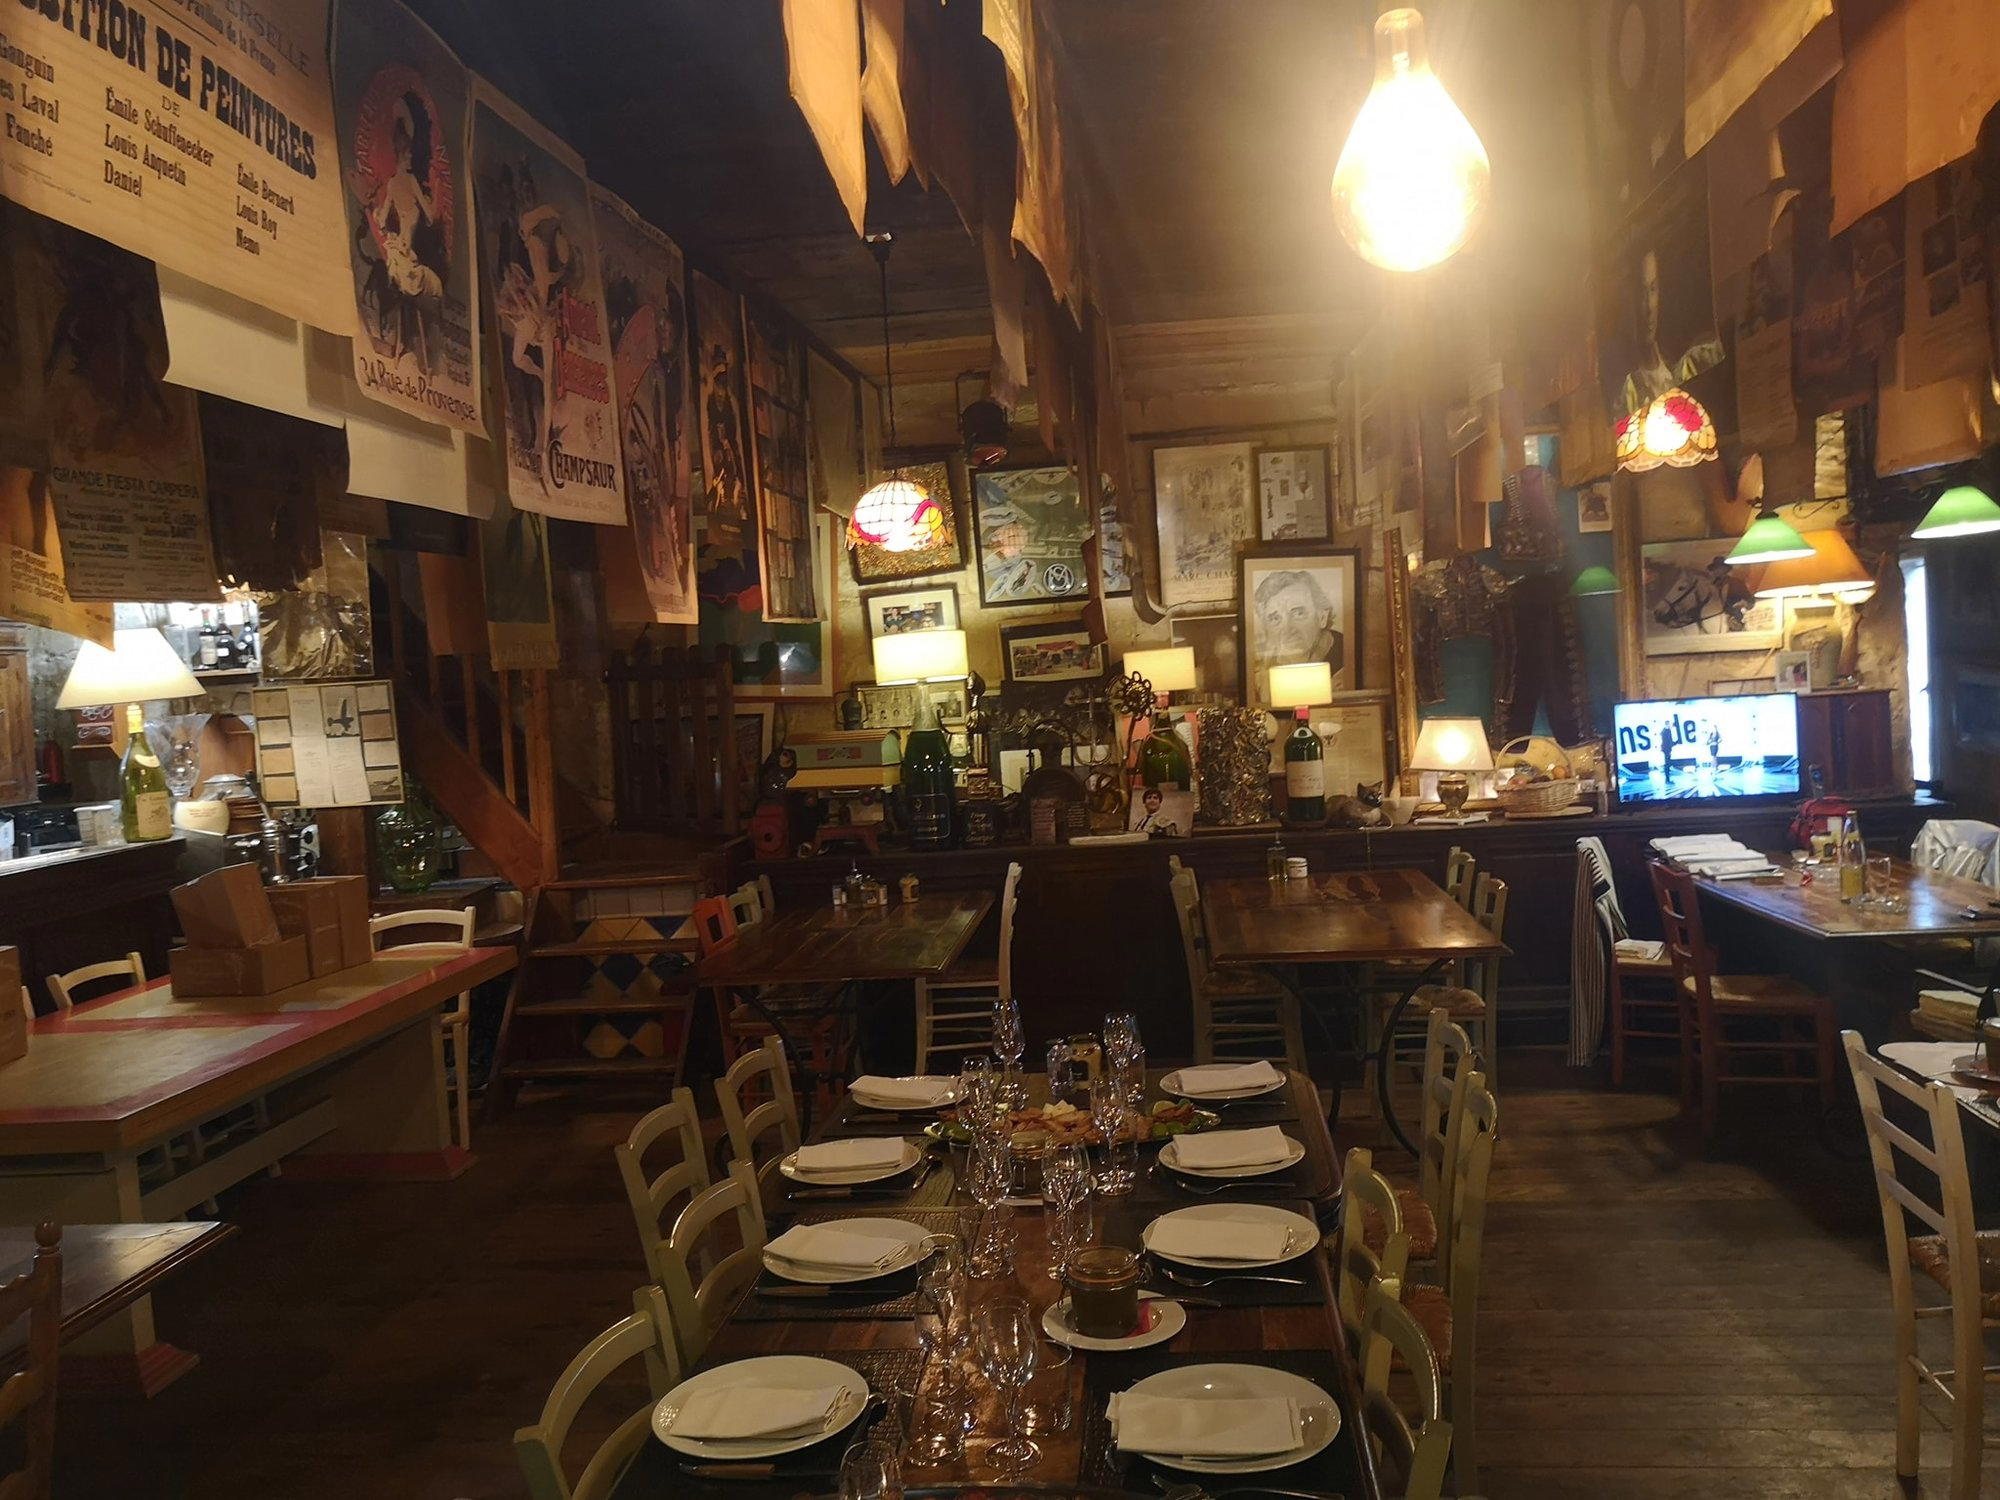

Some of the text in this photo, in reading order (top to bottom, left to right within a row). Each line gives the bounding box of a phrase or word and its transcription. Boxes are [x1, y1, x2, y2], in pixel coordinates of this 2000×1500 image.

[19, 0, 147, 73] ITION
[156, 25, 191, 100] DE
[199, 55, 317, 181] PEINTURES
[20, 83, 59, 123] Laval
[161, 95, 181, 118] DE
[104, 123, 138, 160] Louis
[103, 159, 143, 198] Daniel
[1619, 713, 1697, 755] nsde
